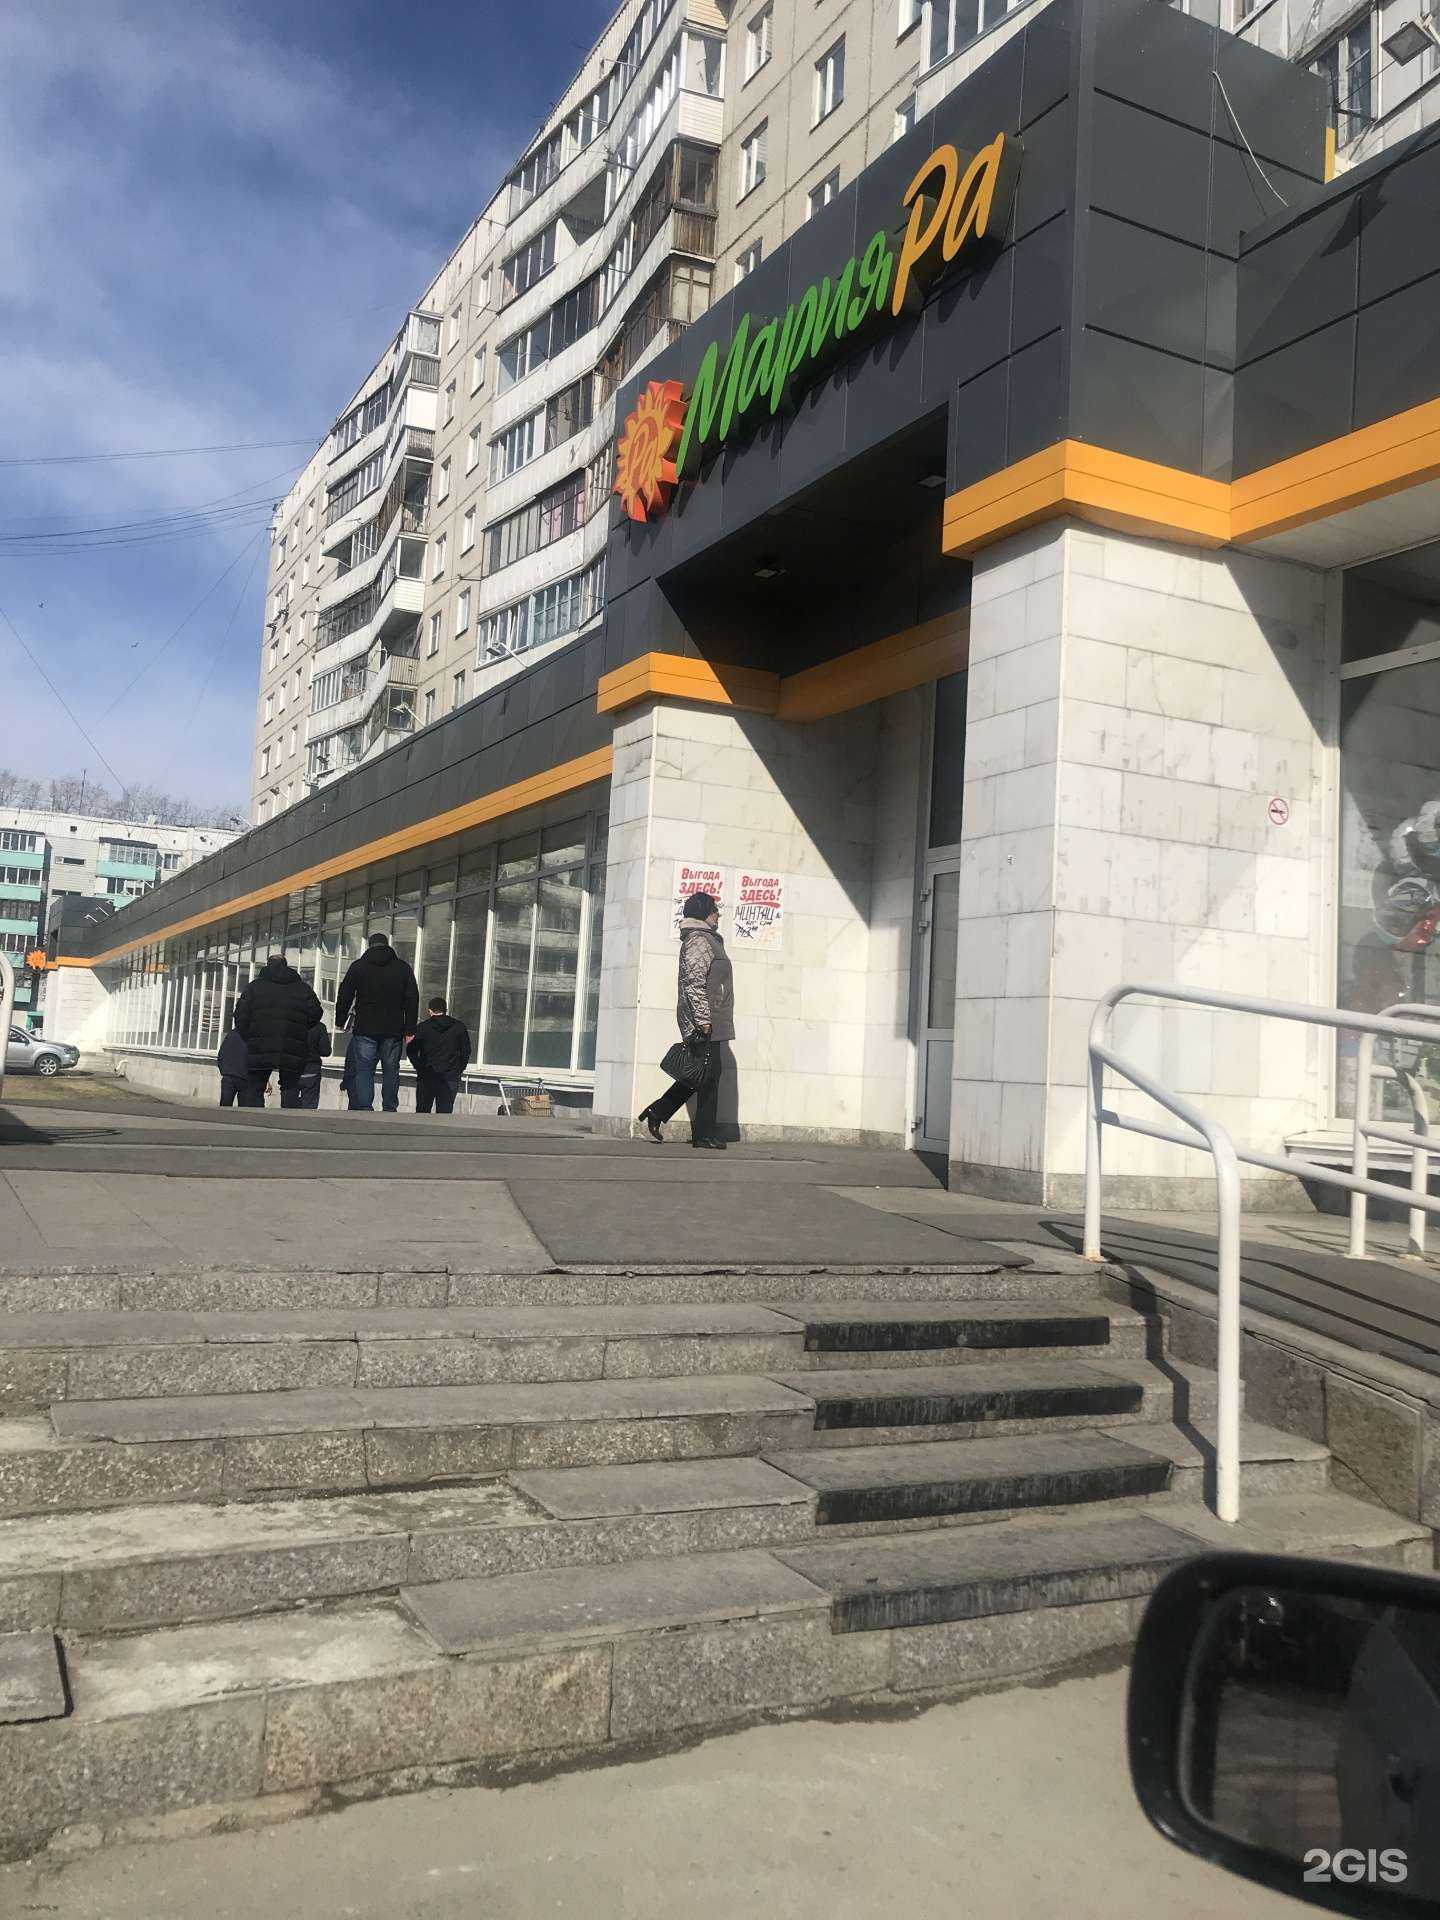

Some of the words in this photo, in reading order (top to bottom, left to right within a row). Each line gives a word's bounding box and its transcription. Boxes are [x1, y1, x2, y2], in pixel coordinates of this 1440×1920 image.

[675, 230, 893, 476] Мария
[891, 132, 1005, 316] Ра
[739, 887, 782, 902] ЗДЕСЬ!
